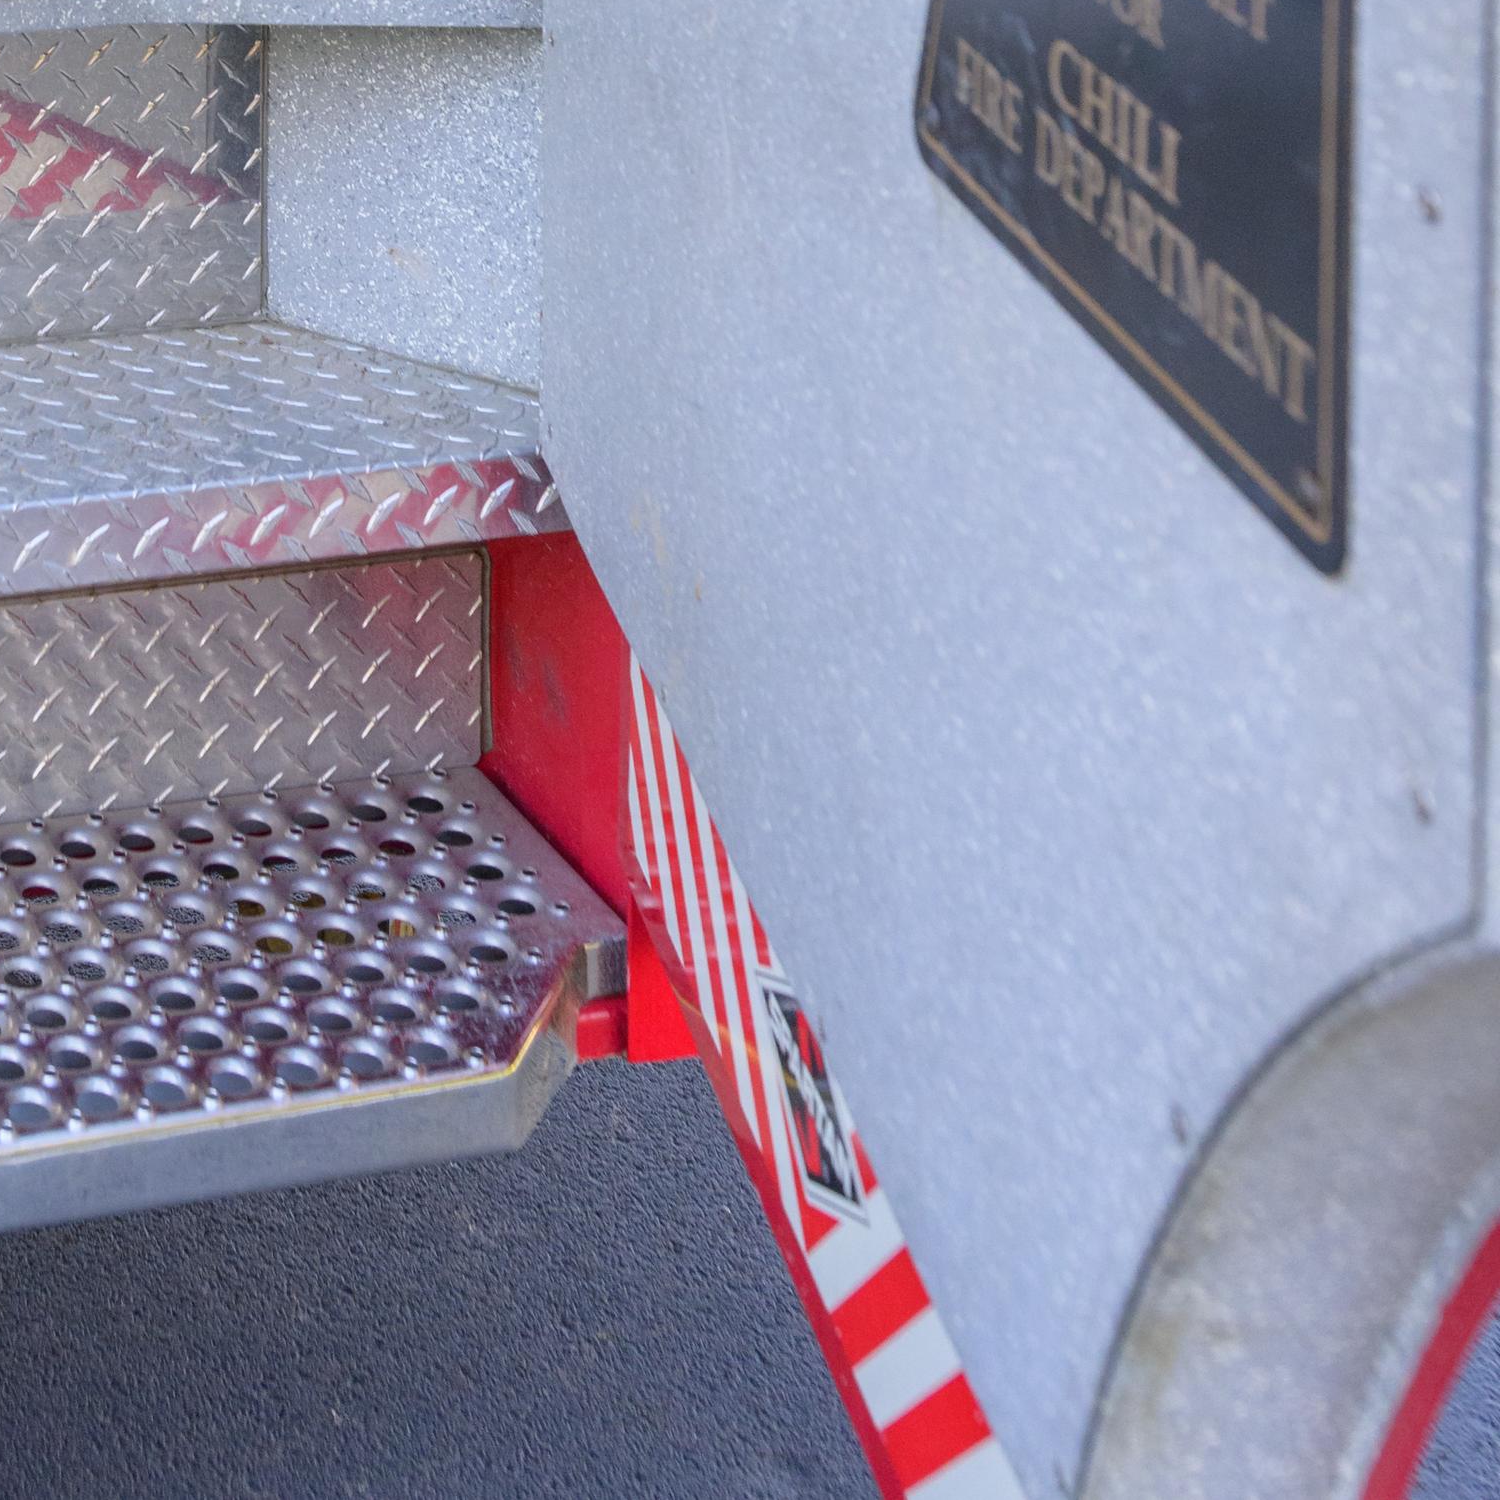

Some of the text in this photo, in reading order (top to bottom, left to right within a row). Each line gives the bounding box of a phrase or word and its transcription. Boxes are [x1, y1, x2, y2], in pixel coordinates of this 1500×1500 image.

[955, 37, 1316, 422] FIRE DEPARTMENT
[1048, 37, 1182, 206] CHILI
